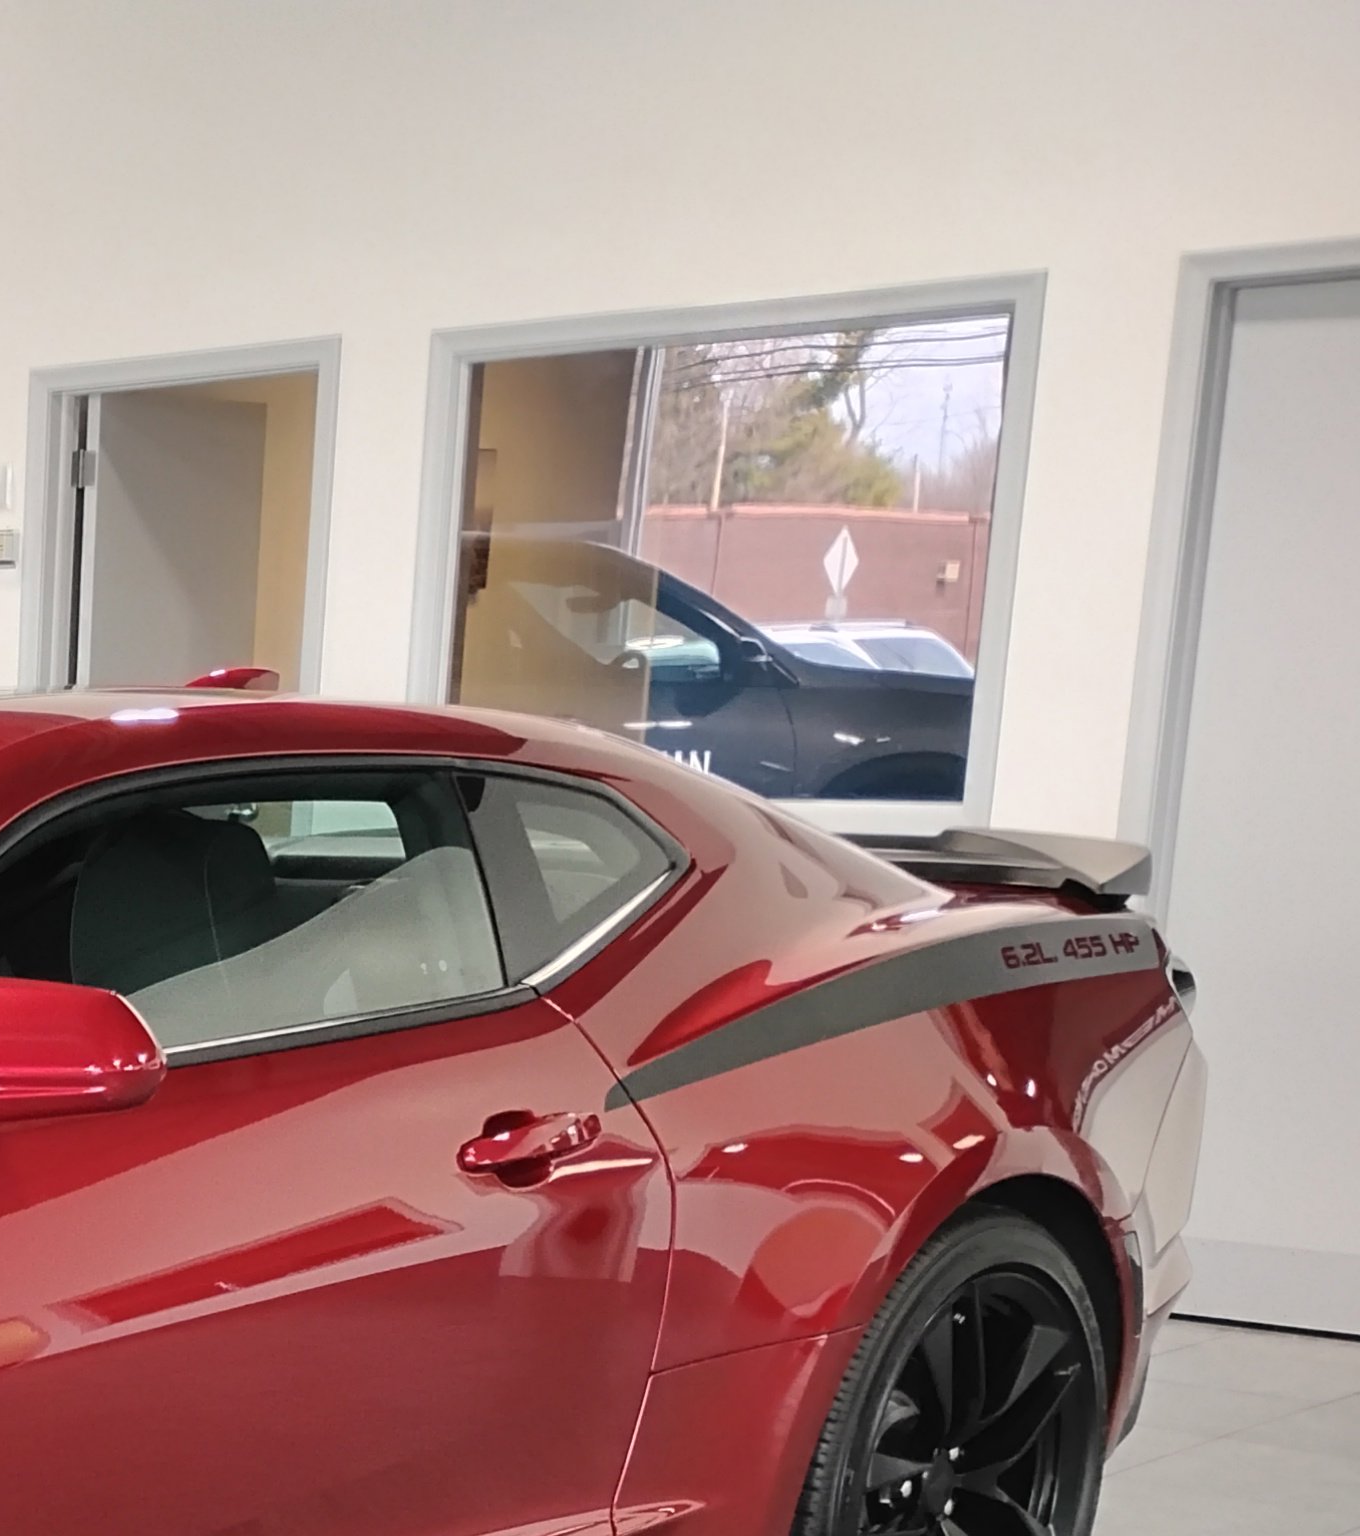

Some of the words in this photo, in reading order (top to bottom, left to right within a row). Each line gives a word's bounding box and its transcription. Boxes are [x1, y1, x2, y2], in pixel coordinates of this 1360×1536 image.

[1001, 942, 1058, 969] 6.2L
[1063, 935, 1107, 959] 455
[1108, 932, 1140, 954] HP
